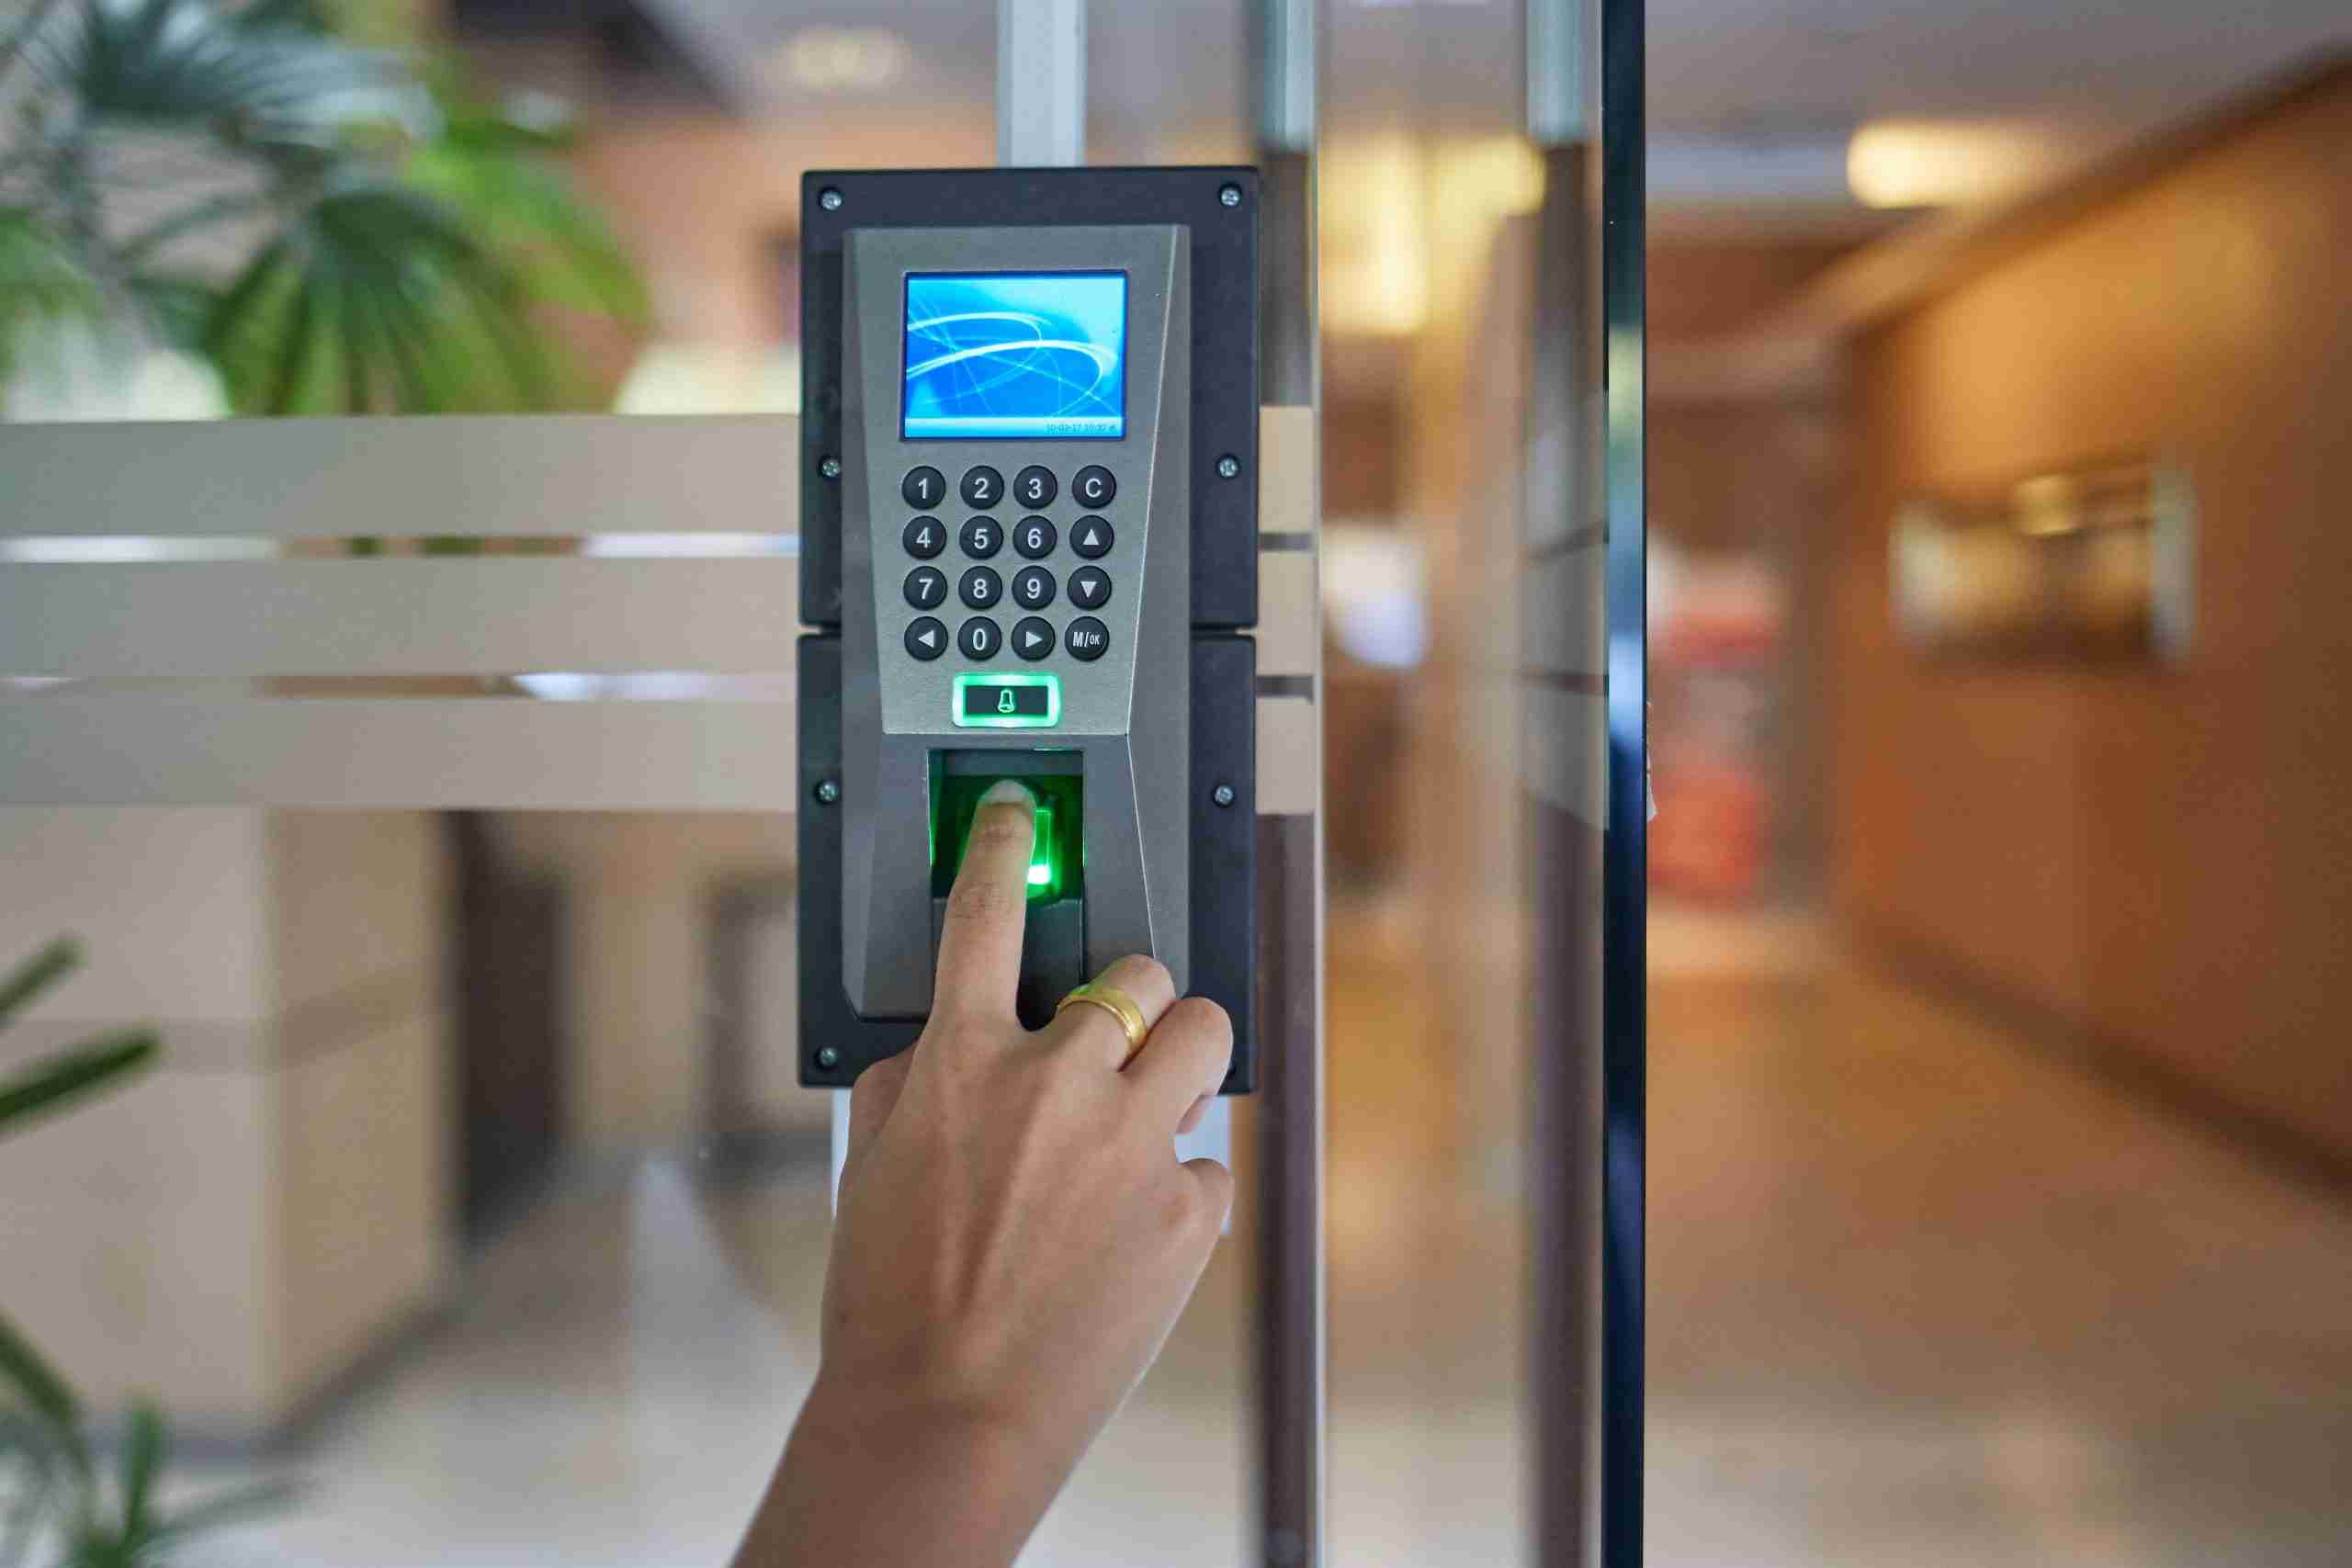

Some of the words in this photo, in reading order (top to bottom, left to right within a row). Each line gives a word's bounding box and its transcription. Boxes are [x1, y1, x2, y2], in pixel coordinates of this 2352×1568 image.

[918, 478, 927, 499] 1
[974, 477, 989, 499] 2
[1028, 478, 1042, 500] 3
[1085, 478, 1102, 498] C
[916, 527, 931, 548] 4
[974, 528, 989, 549] 5
[1027, 527, 1042, 549] 6
[918, 578, 933, 600] 7
[973, 578, 988, 599] 8
[1026, 578, 1041, 599] 9
[972, 628, 987, 650] 0
[1072, 631, 1101, 648] M/OK
